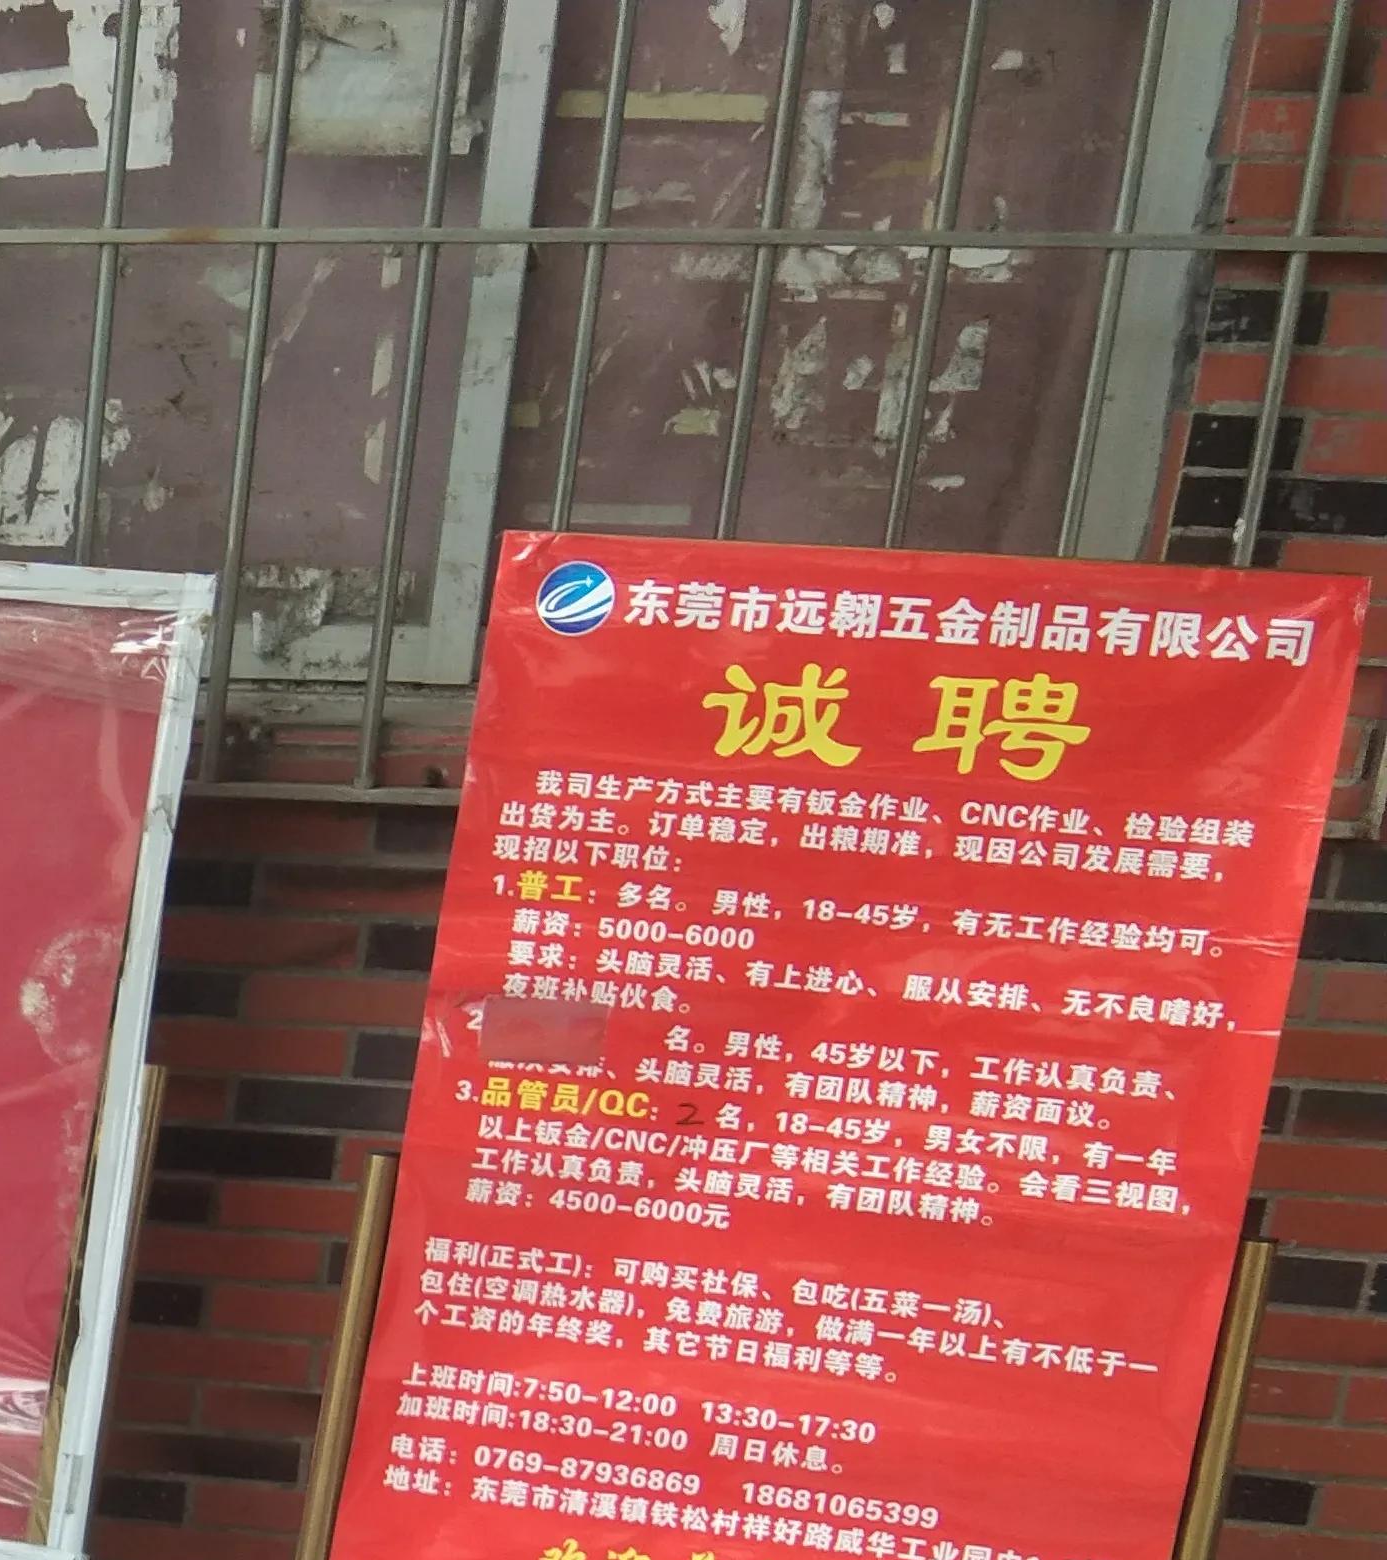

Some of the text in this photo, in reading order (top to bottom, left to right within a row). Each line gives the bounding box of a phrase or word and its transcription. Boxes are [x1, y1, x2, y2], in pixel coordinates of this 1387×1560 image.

[623, 578, 1318, 668] 东莞市远翱五金制品有限公司
[492, 834, 684, 873] 现招以下职位：
[512, 907, 755, 950] 薪资：5000-6000
[502, 971, 691, 1014] 夜班补贴伙食。
[465, 1176, 731, 1230] 薪资：4500-6000元
[701, 1400, 877, 1445] 13:30-17:30
[709, 1430, 844, 1475] 周日休息。
[740, 1481, 940, 1531] 18681065399
